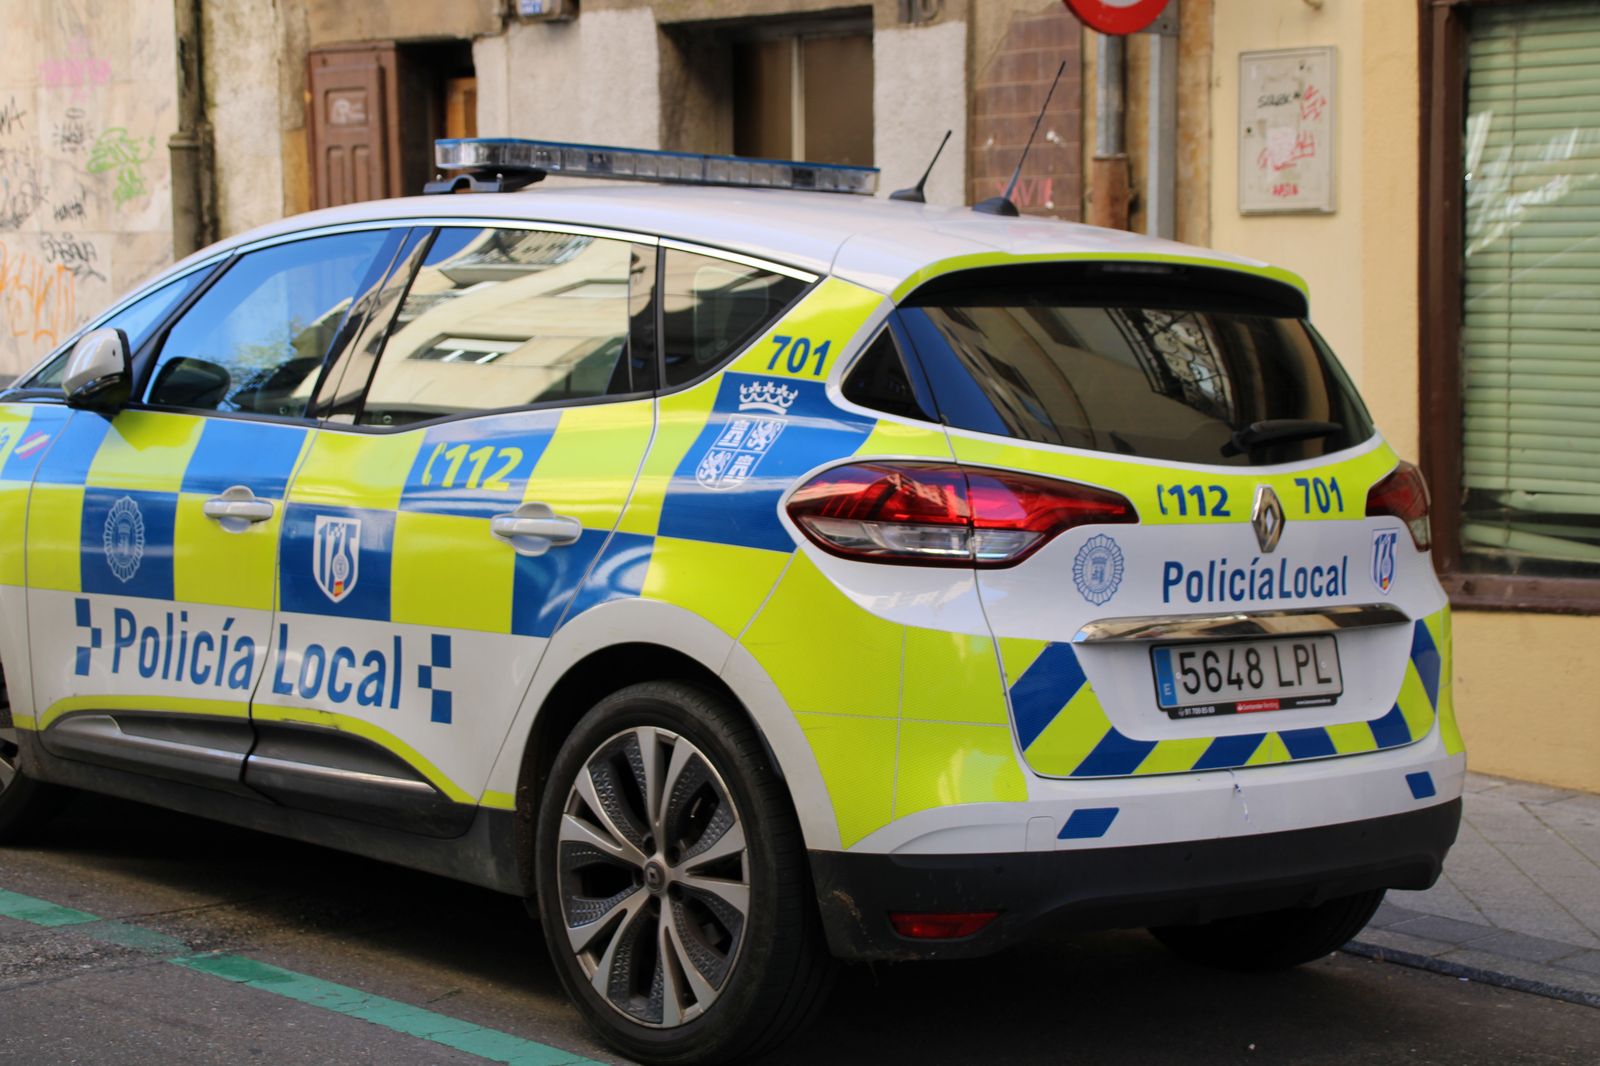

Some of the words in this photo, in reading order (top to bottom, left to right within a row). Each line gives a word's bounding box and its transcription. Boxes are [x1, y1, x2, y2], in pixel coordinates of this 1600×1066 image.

[767, 335, 832, 376] 701
[441, 443, 524, 492] 112
[1168, 484, 1231, 517] 112
[1294, 476, 1344, 514] 701
[1163, 556, 1274, 603] Policía
[1278, 555, 1349, 599] Local
[111, 607, 256, 691] Policía
[271, 622, 403, 710] Local
[1178, 647, 1264, 695] 5648
[1273, 642, 1333, 688] LPL
[1163, 683, 1172, 696] E
